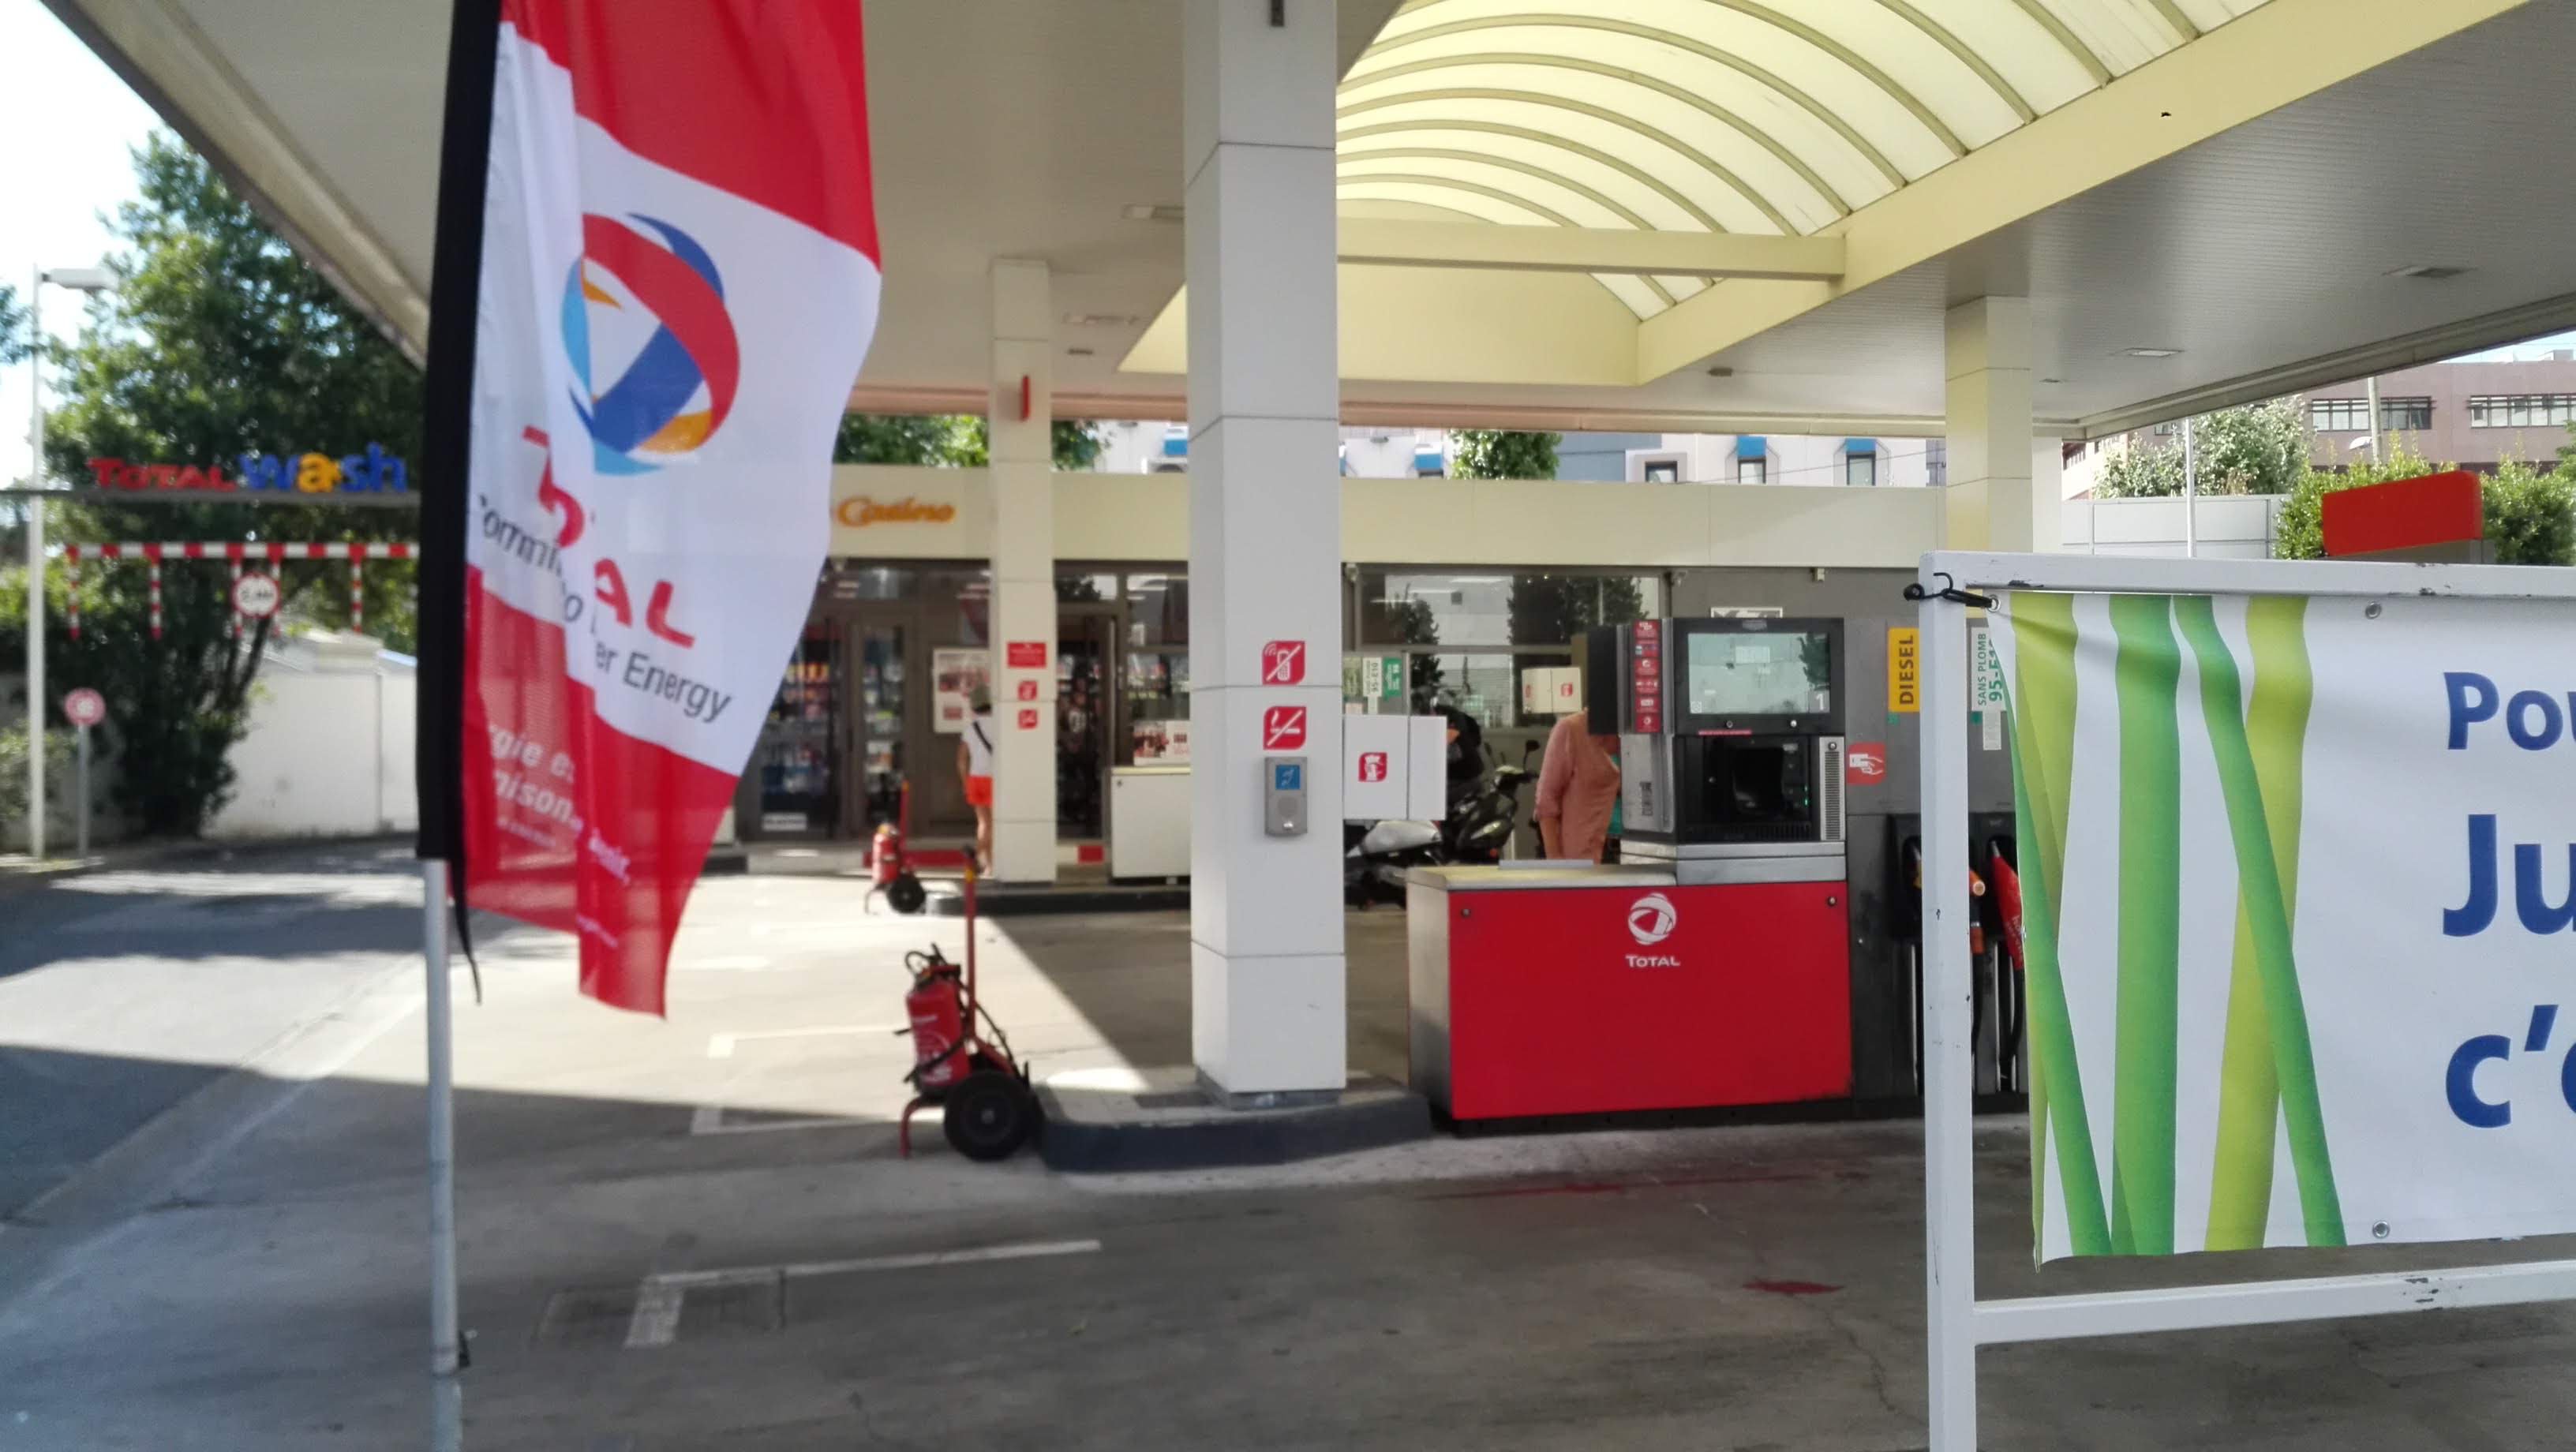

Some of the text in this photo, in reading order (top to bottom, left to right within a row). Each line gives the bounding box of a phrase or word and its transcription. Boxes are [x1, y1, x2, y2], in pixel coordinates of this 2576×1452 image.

[88, 441, 406, 493] TOTAL wash
[622, 651, 733, 724] Energy
[1899, 634, 1914, 705] DIESEL
[1978, 633, 1986, 706] SANS PLOMB
[1988, 638, 2003, 702] 95-E
[2443, 672, 2576, 751] Po
[1625, 953, 1681, 968] TOTAL
[2445, 1004, 2576, 1129] c'
